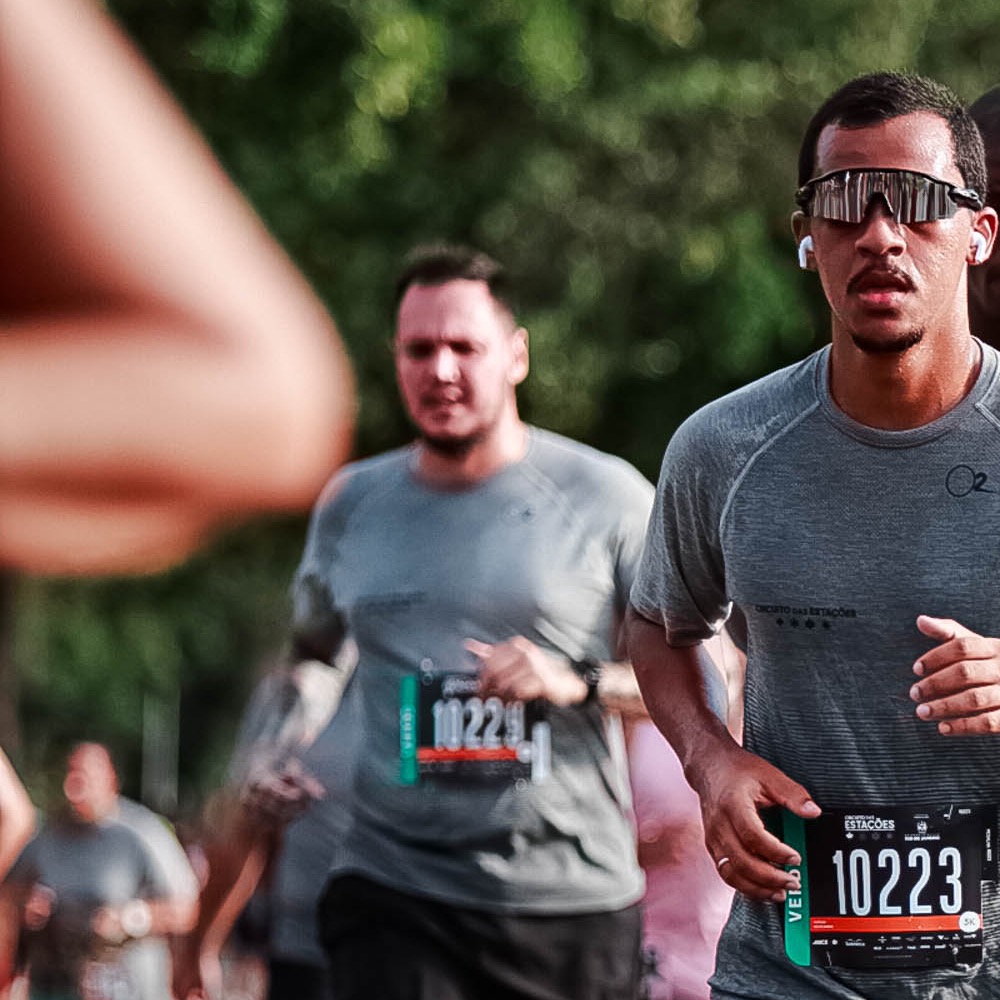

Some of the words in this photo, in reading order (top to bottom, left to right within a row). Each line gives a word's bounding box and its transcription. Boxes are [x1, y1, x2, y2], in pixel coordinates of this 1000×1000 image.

[844, 817, 895, 831] ESTAÇÕES
[788, 868, 802, 922] VED
[832, 847, 962, 916] 10223
